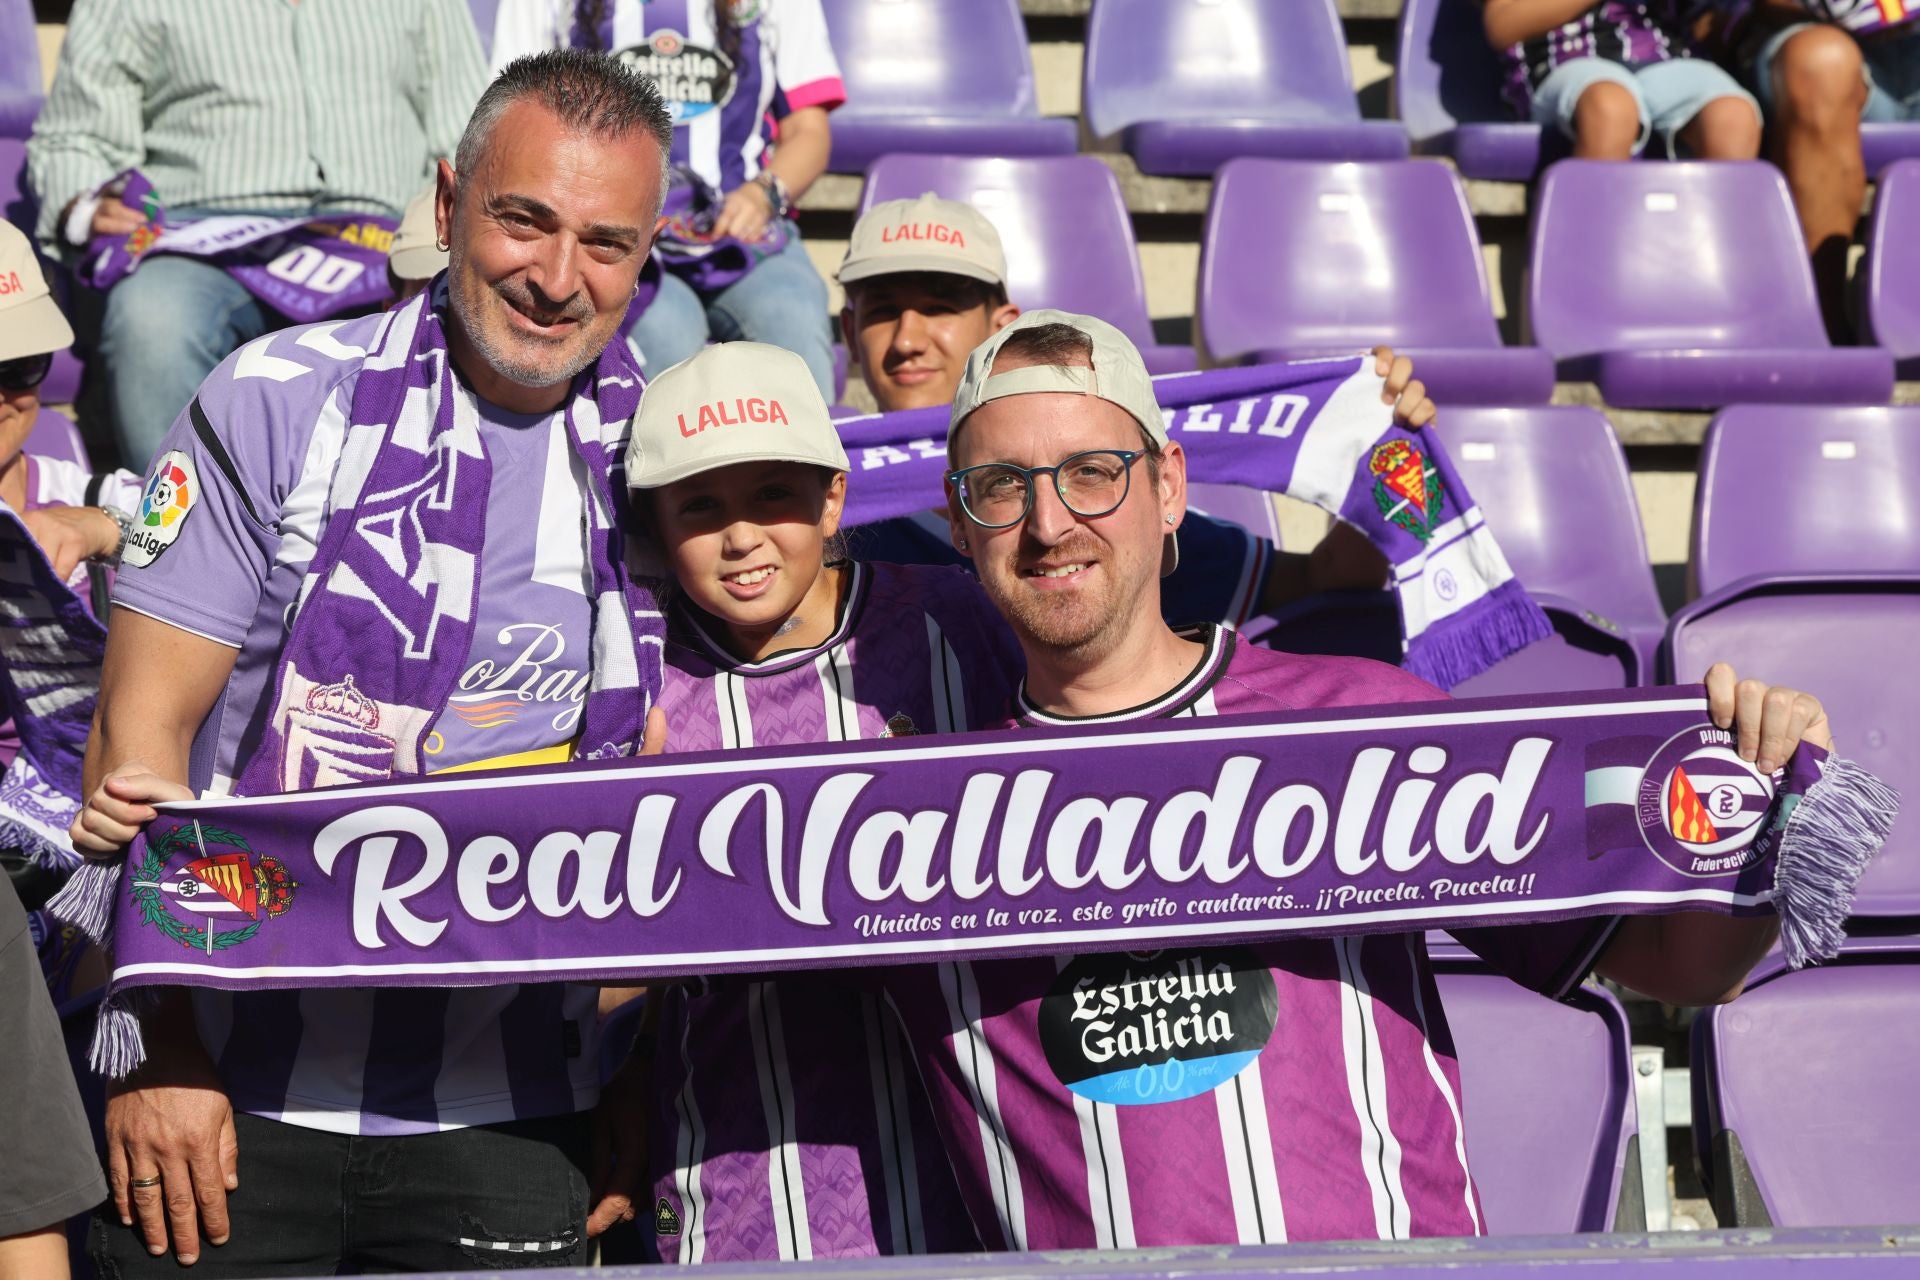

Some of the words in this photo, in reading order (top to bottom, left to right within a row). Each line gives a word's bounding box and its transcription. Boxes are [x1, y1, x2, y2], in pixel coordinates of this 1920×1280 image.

[881, 222, 965, 249] LALIGA
[676, 397, 789, 438] LALIGA
[1719, 789, 1734, 814] RV
[312, 794, 682, 949] Real
[699, 737, 1554, 926] Valladolid
[1691, 848, 1757, 872] Federación
[853, 911, 943, 937] Unidos
[950, 914, 979, 929] en
[985, 907, 1011, 927] la
[1072, 899, 1114, 922] este
[1121, 896, 1178, 924] grito
[1428, 873, 1536, 902] Pucela!!
[1070, 955, 1237, 1023] Estrella
[1081, 1002, 1235, 1063] Galicia
[1134, 1057, 1185, 1098] 0,0
